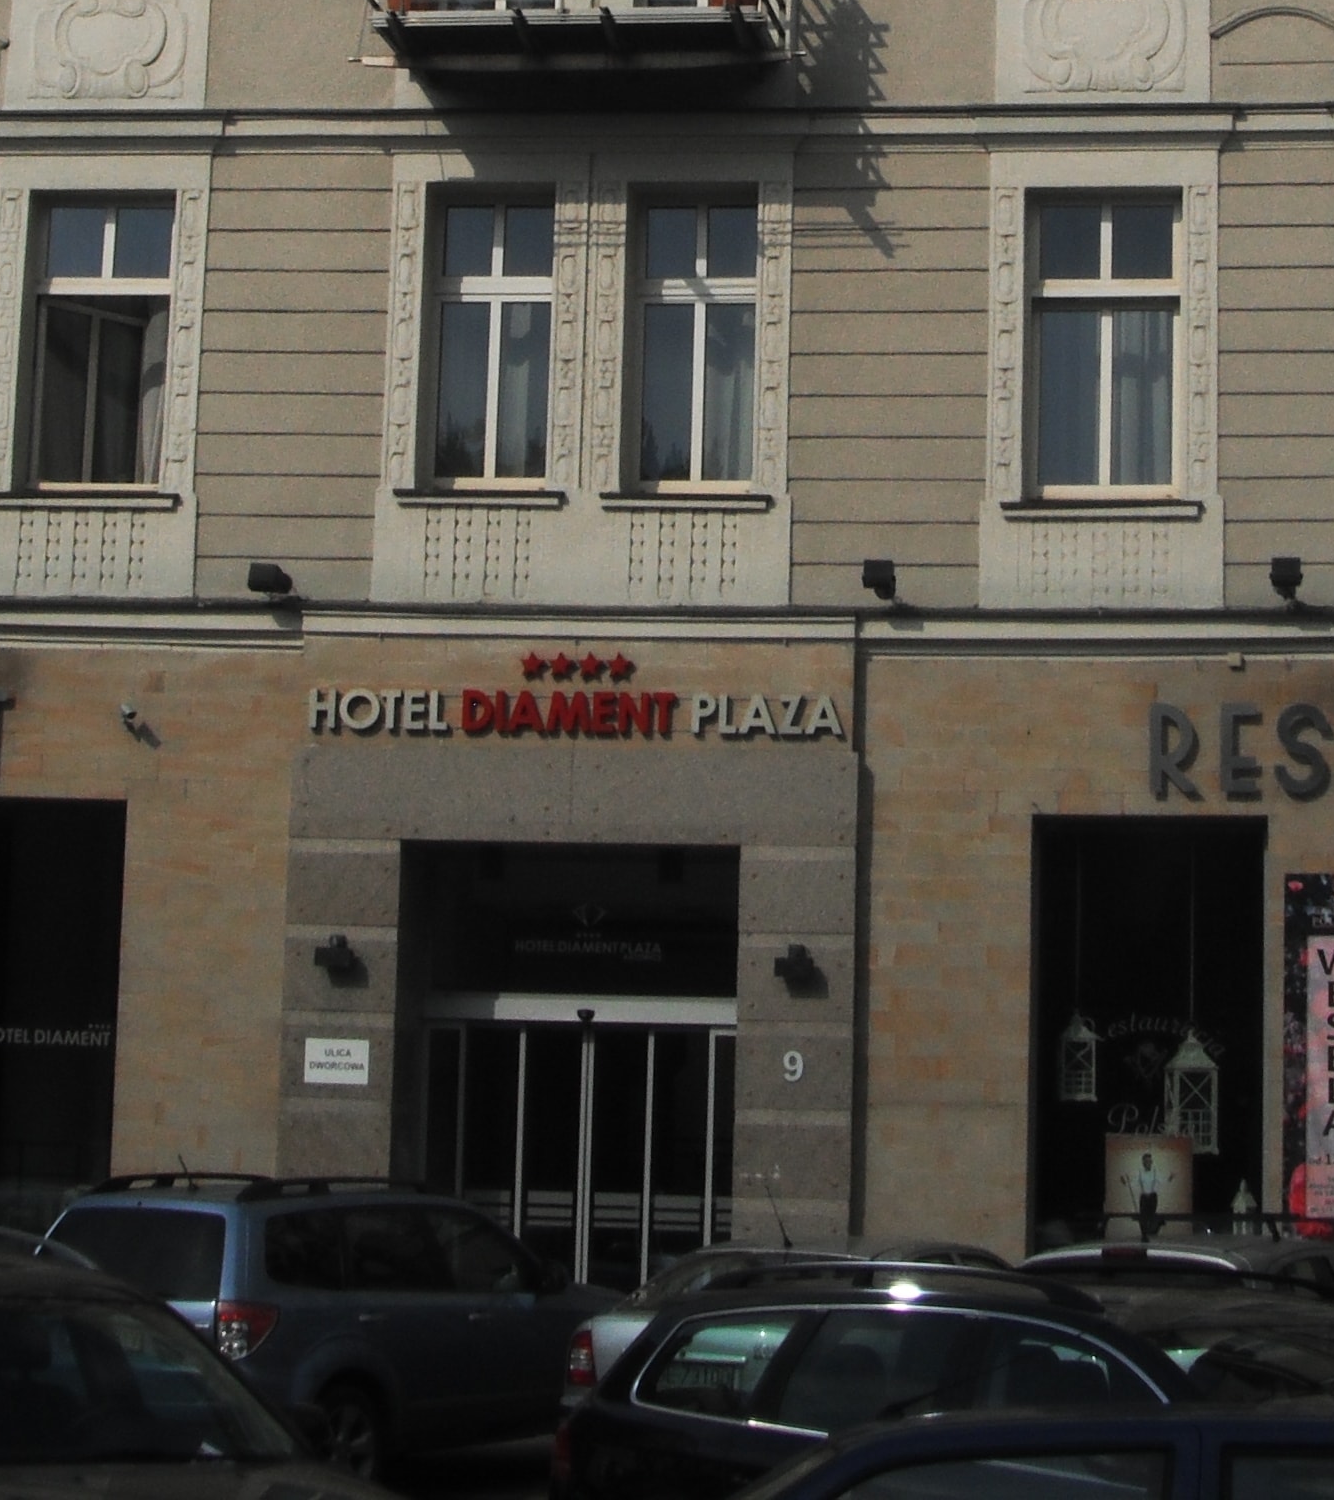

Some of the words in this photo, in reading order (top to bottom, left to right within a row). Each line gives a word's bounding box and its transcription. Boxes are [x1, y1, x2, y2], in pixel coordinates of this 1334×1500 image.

[308, 688, 449, 732] HOTEL
[462, 689, 677, 736] DIAMENT
[690, 693, 845, 736] PLAZA
[514, 939, 556, 953] HOTEL
[557, 940, 618, 954] DIAMENT
[619, 941, 663, 955] PLAZA
[34, 1029, 111, 1047] DIAMENT
[324, 1048, 352, 1058] ULICA
[309, 1061, 366, 1072] DWORCOWA
[782, 1051, 804, 1082] 9
